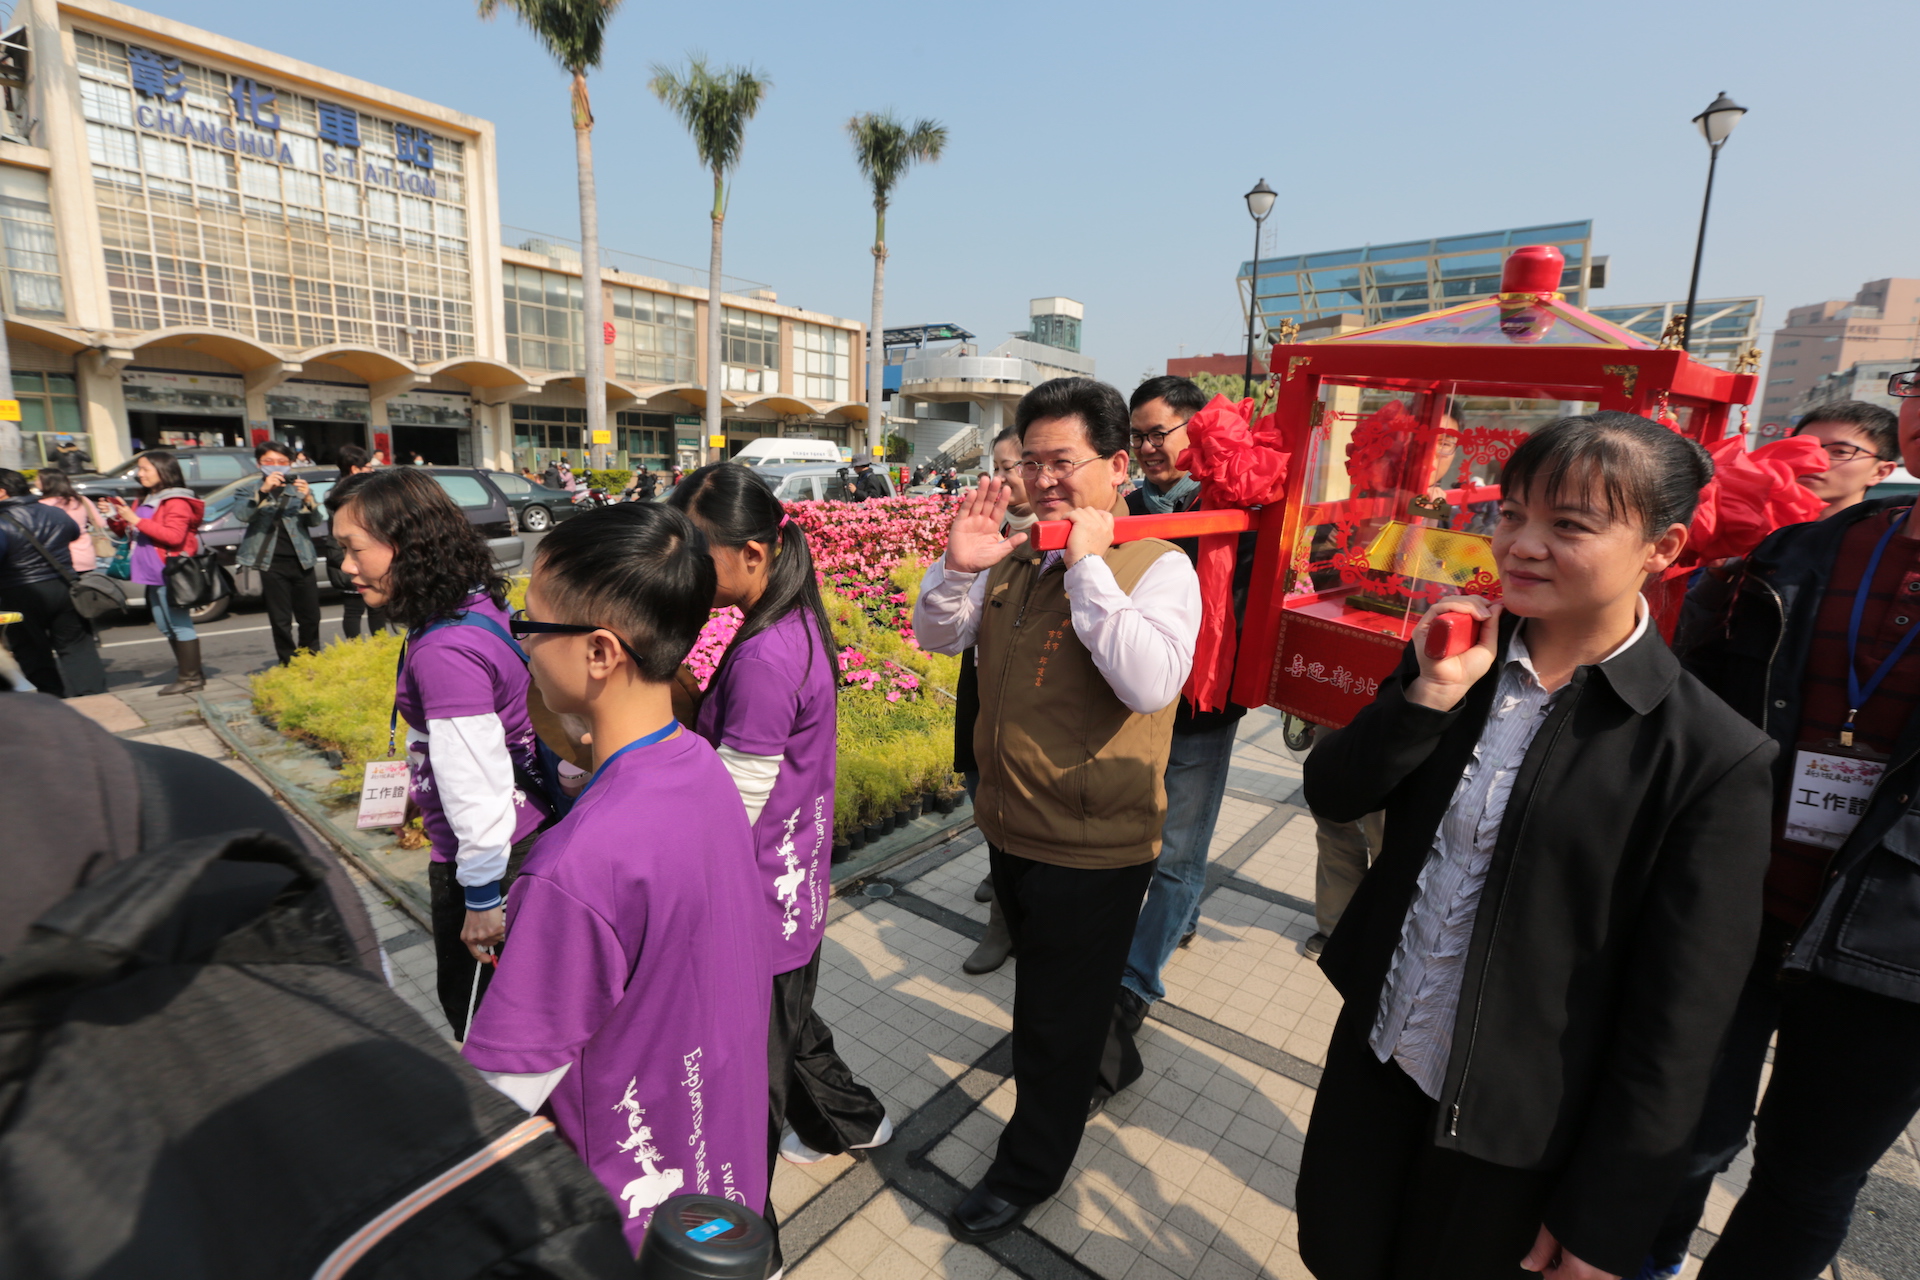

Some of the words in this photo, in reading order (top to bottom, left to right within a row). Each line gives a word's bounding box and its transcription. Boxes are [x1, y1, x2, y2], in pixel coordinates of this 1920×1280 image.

[128, 46, 434, 169] 彰化車站
[136, 104, 294, 165] CHANGHUA
[323, 152, 436, 198] STATION
[1284, 653, 1379, 697] 喜迎新北
[364, 785, 405, 801] 工作證
[681, 1046, 703, 1147] Exploring
